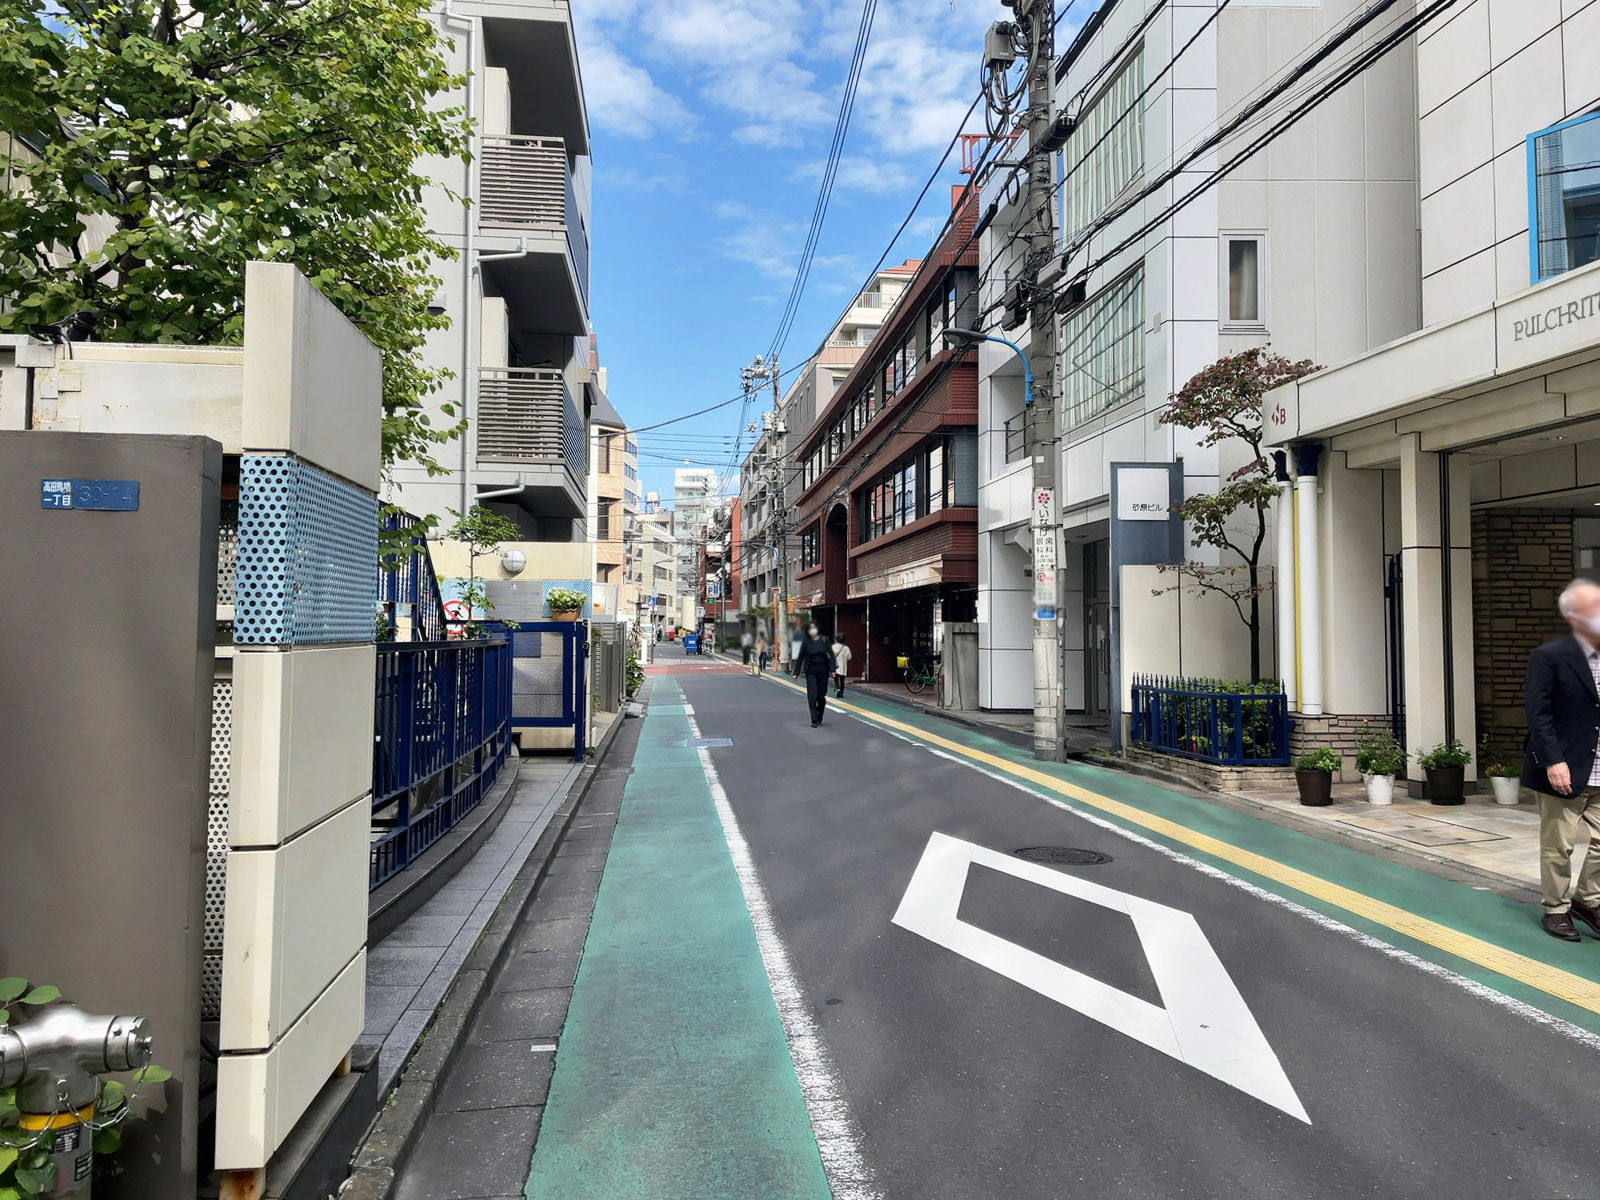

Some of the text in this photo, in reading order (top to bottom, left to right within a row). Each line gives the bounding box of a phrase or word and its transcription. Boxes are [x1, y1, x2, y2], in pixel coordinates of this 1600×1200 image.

[1513, 291, 1600, 342] PULCHRIT
[43, 481, 72, 493] 高田馬場
[43, 494, 71, 506] 一丁目
